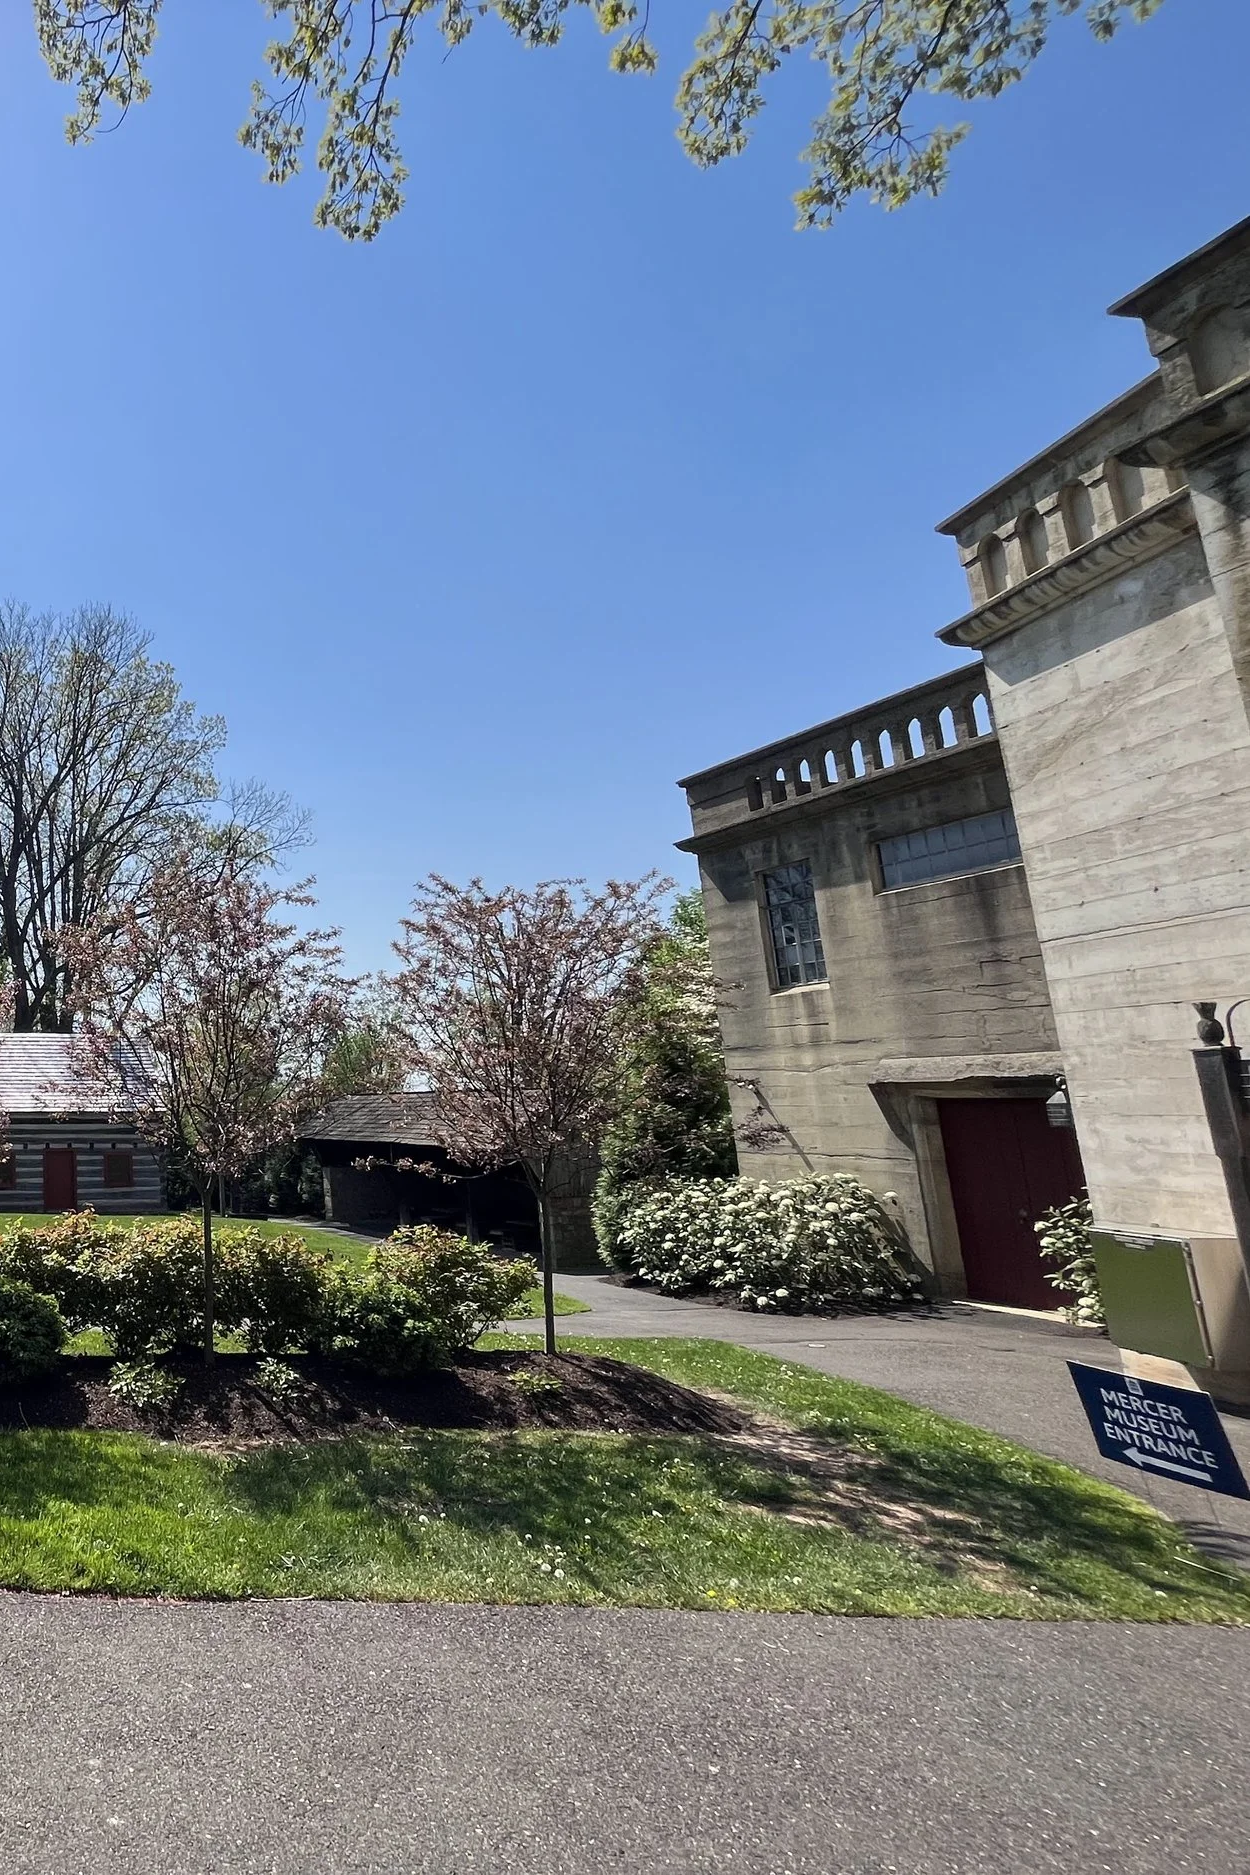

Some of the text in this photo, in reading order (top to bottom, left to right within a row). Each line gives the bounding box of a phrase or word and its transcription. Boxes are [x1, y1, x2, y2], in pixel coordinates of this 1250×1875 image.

[1100, 1387, 1188, 1424] MERCER
[1104, 1405, 1200, 1446] MUSEUM
[1104, 1422, 1219, 1469] ENTRANCE
